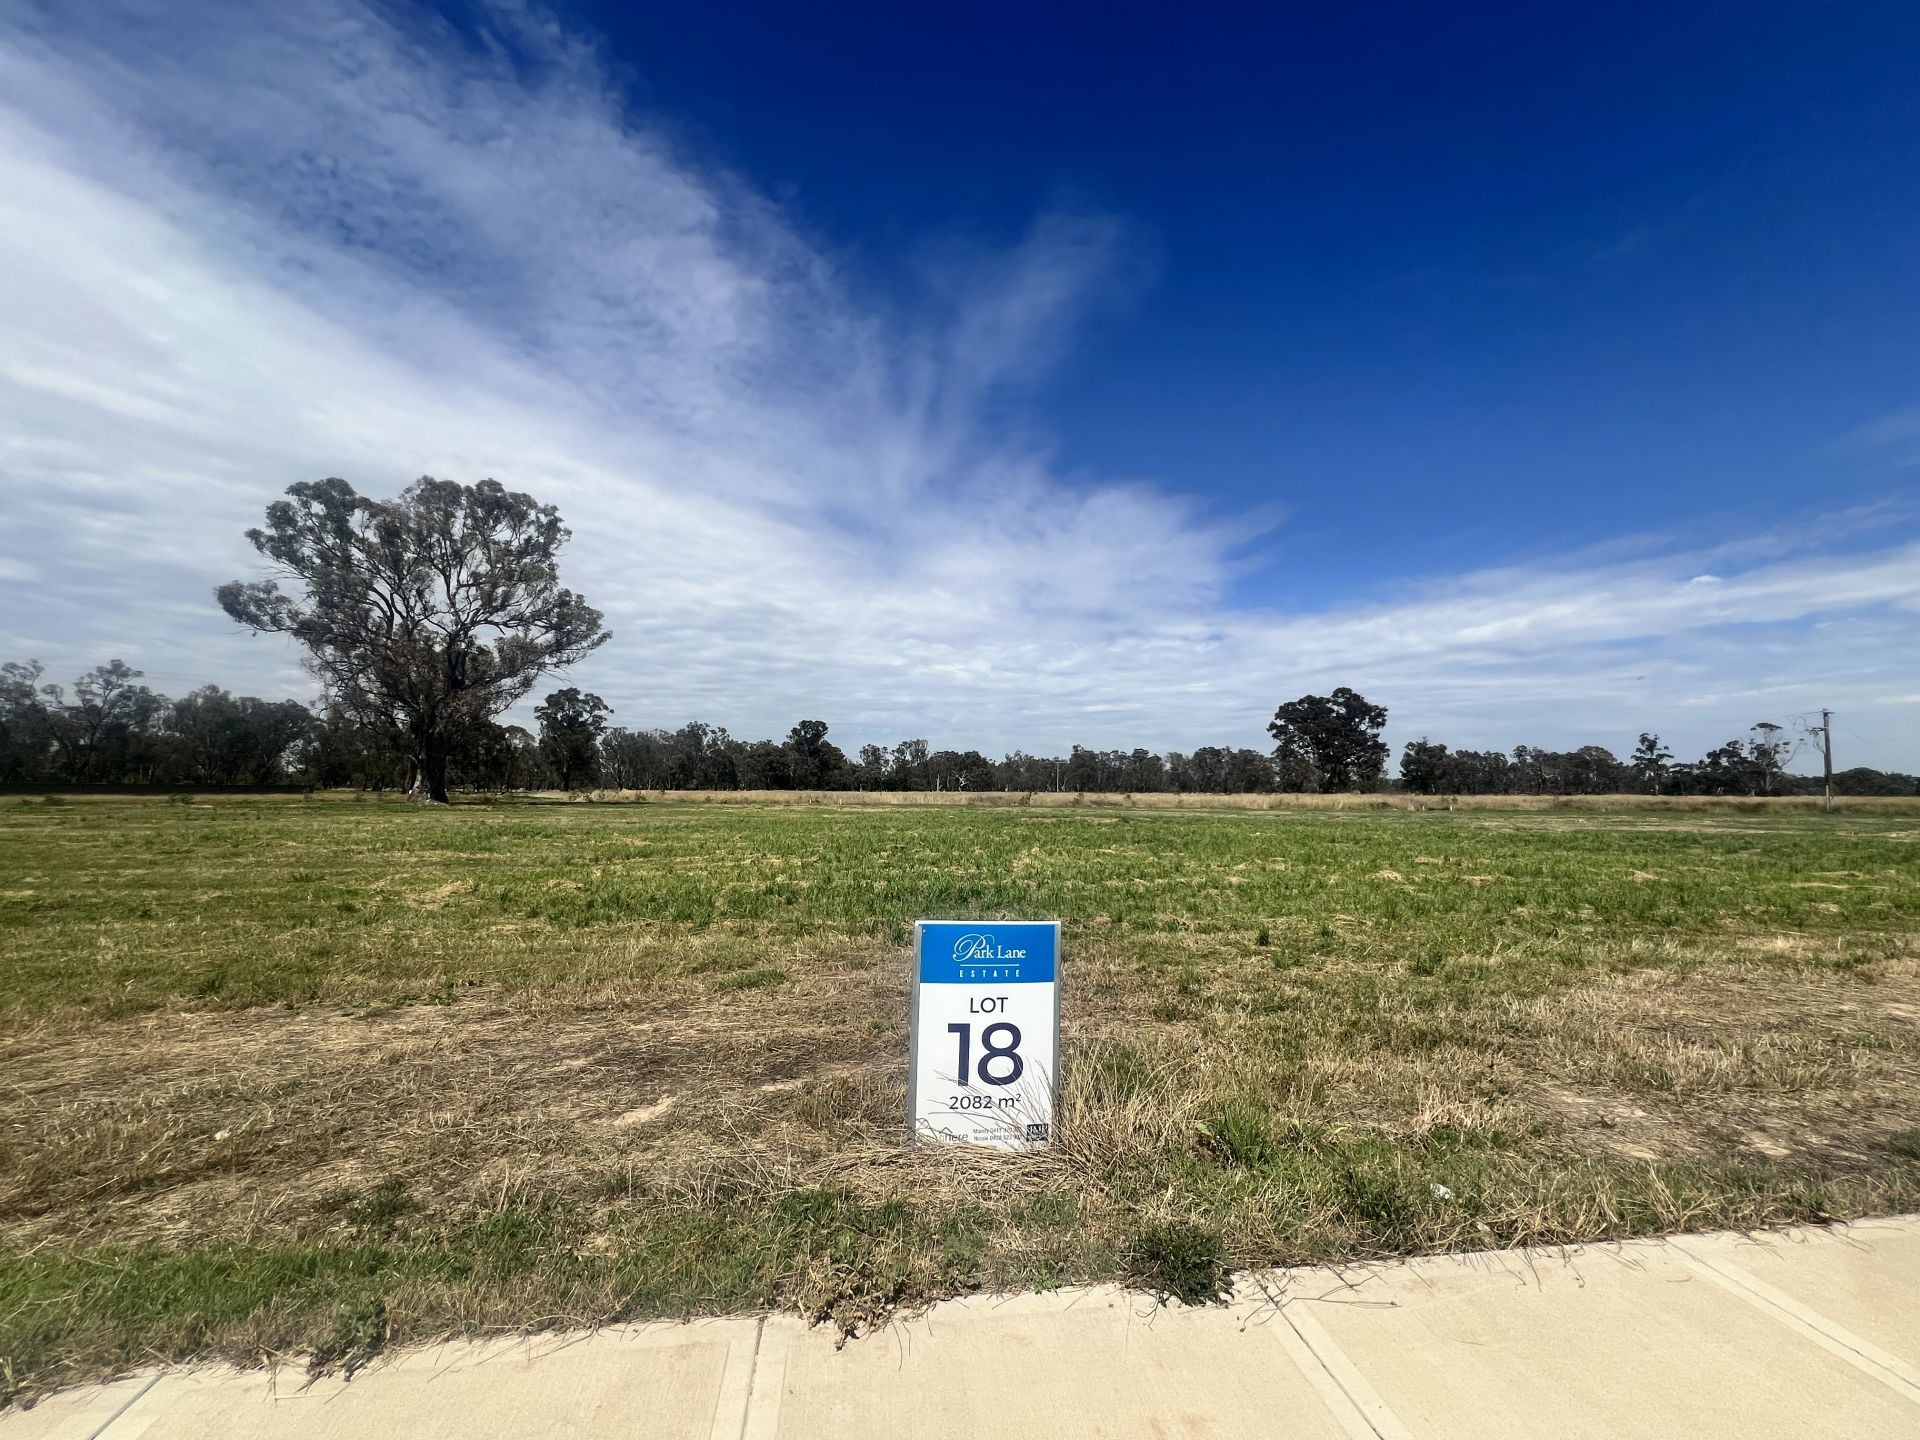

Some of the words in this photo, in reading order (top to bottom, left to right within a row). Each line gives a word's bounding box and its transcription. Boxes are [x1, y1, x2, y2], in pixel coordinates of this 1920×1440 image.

[952, 933, 995, 962] Park
[997, 945, 1027, 959] Lane
[959, 969, 1020, 978] ESTATE
[970, 997, 1009, 1013] LOT
[947, 1022, 1024, 1086] 18
[949, 1095, 993, 1110] 2082
